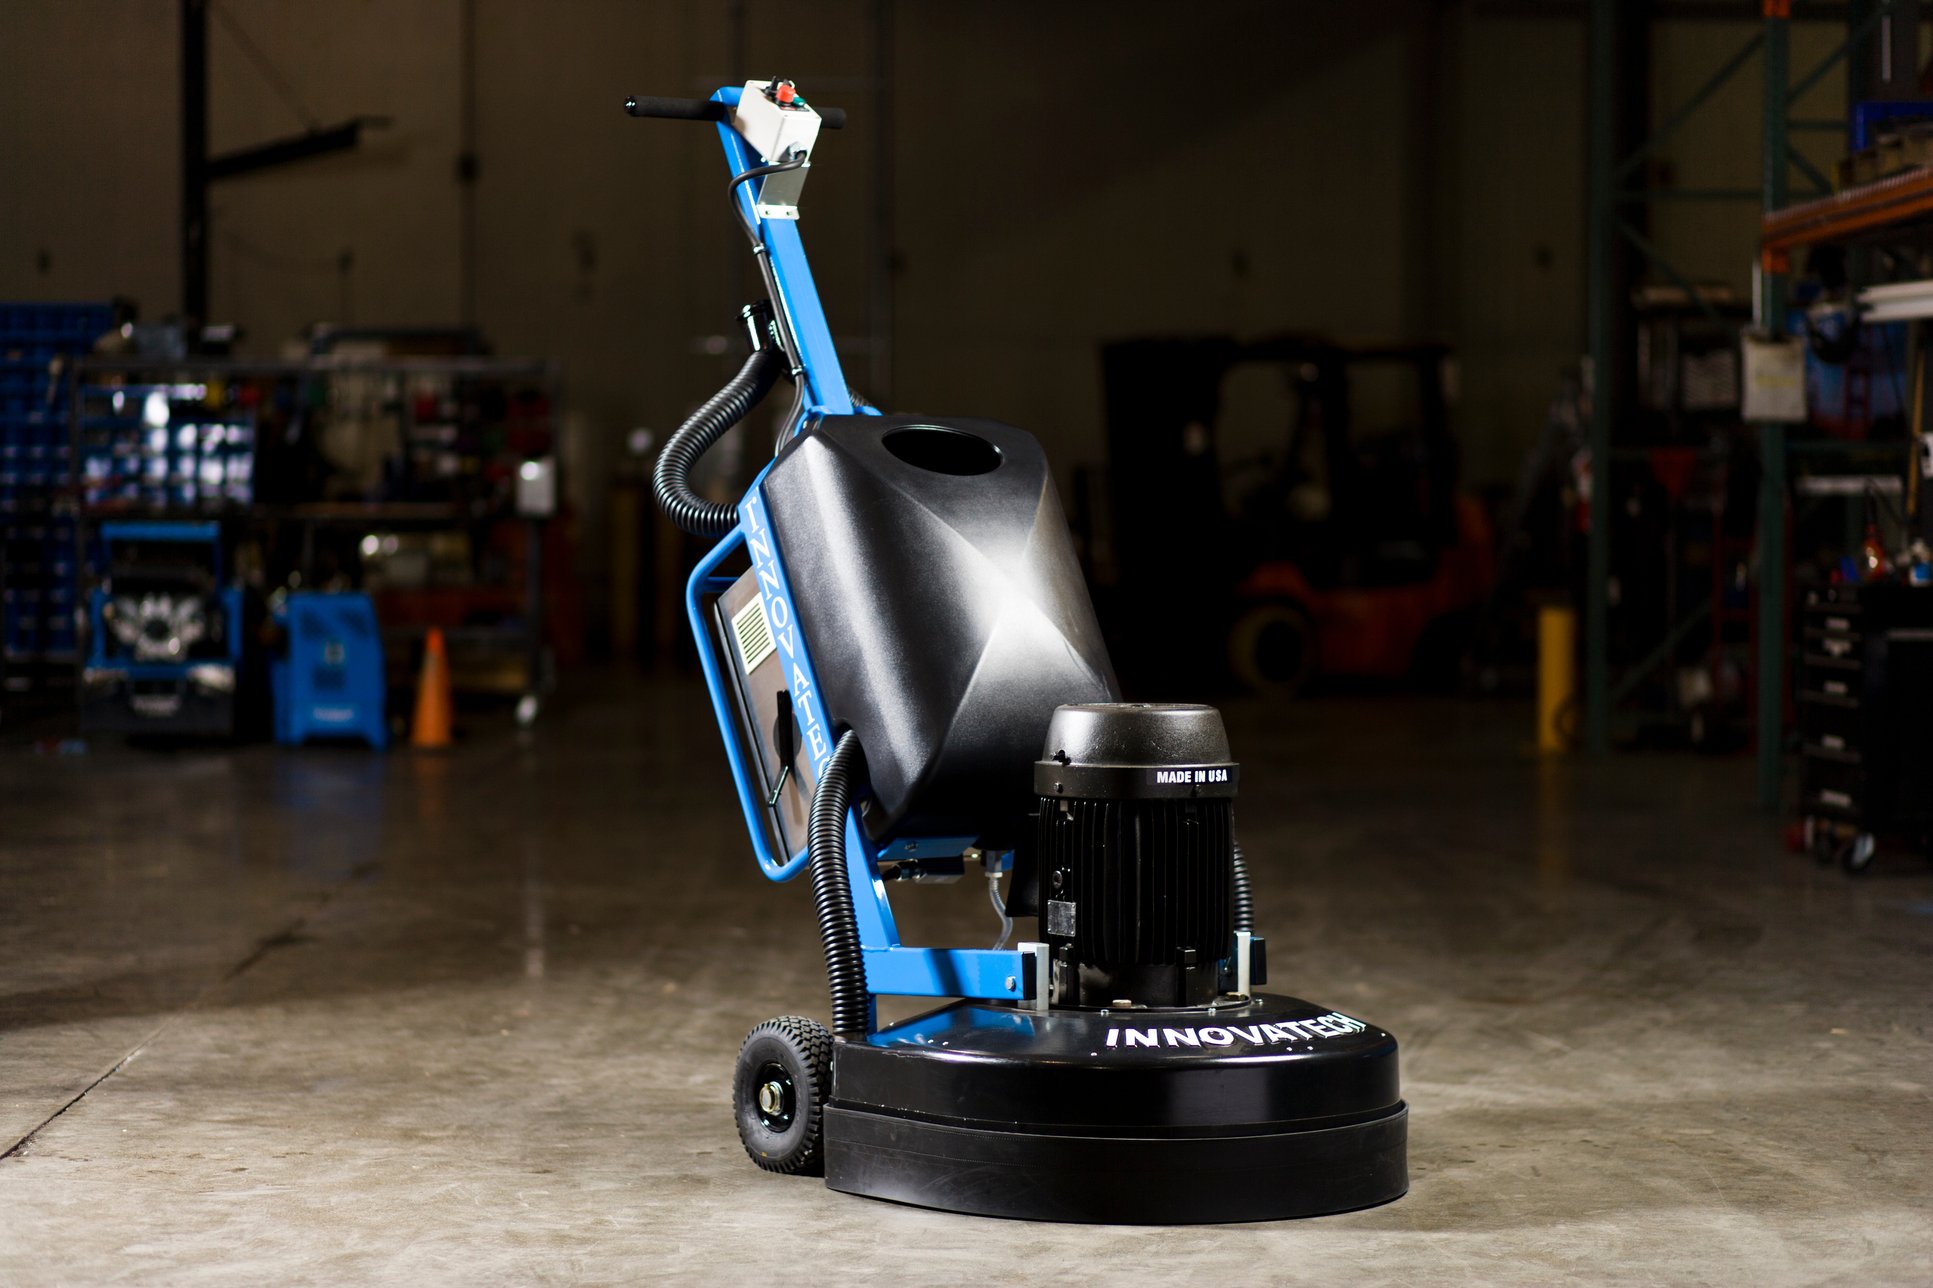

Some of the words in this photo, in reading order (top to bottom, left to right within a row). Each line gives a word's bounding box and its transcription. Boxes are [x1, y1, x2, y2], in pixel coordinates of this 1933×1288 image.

[745, 496, 831, 779] INNOVATE
[1156, 770, 1192, 783] MADE
[1194, 770, 1206, 783] IN
[1208, 769, 1228, 782] USA
[1105, 1011, 1367, 1048] INNOVATECH
